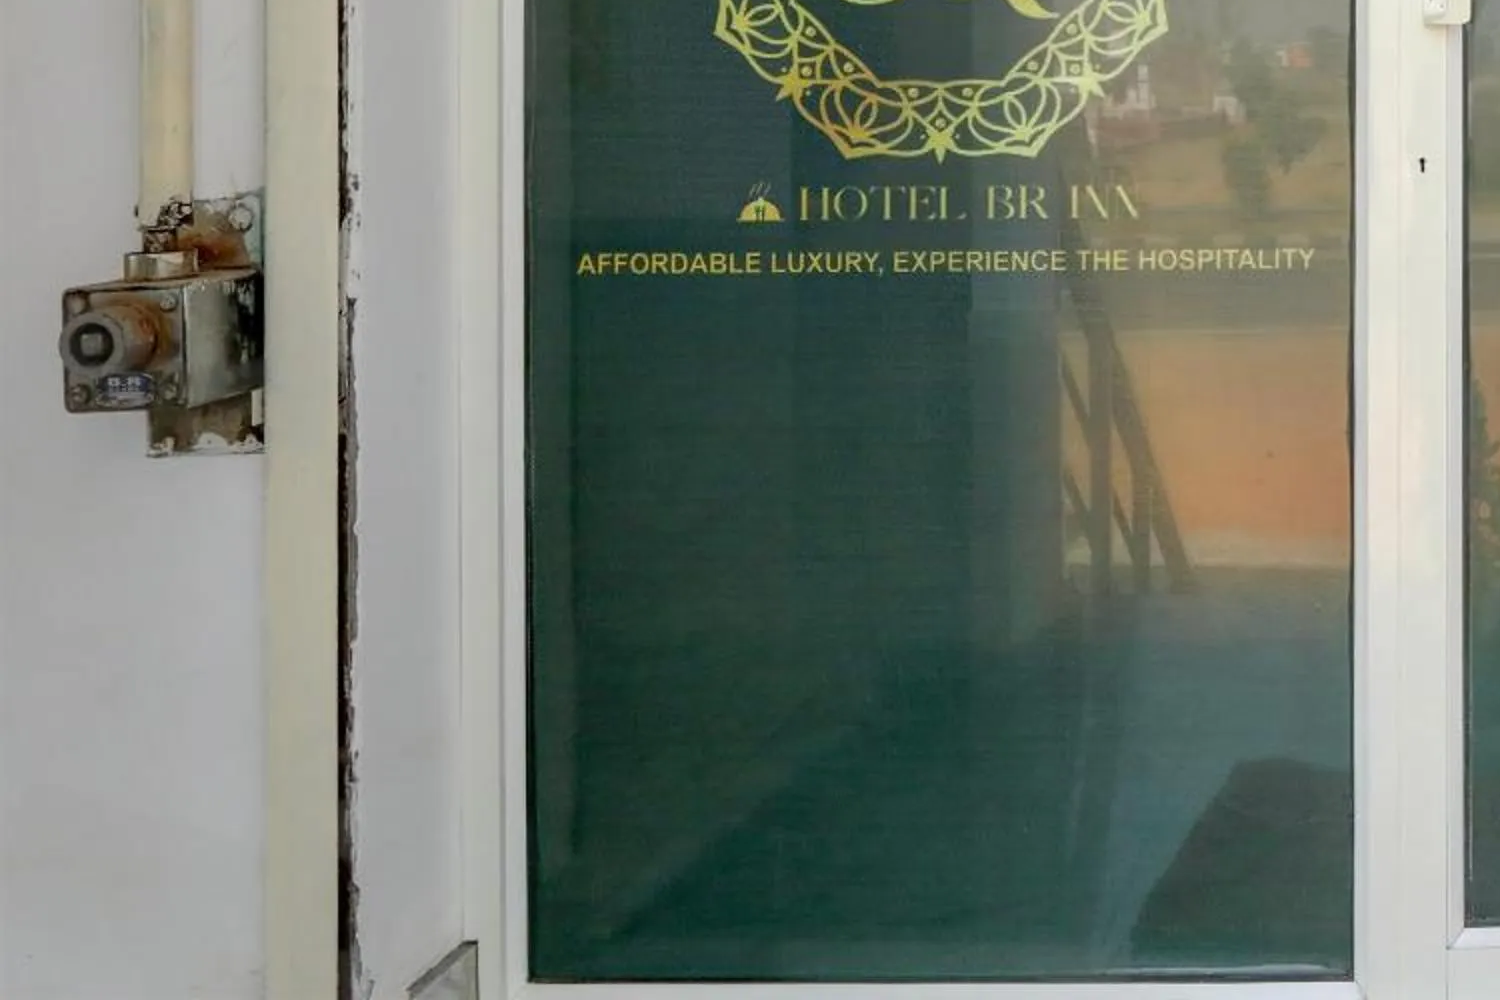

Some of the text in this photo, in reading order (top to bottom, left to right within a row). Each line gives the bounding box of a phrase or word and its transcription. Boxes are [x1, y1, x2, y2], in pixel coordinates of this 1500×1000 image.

[800, 183, 1141, 221] HOTEL BR INN
[576, 247, 1316, 277] AFFORDABLE LUXURY, EXPERIENCE THE HOSPITALITY
